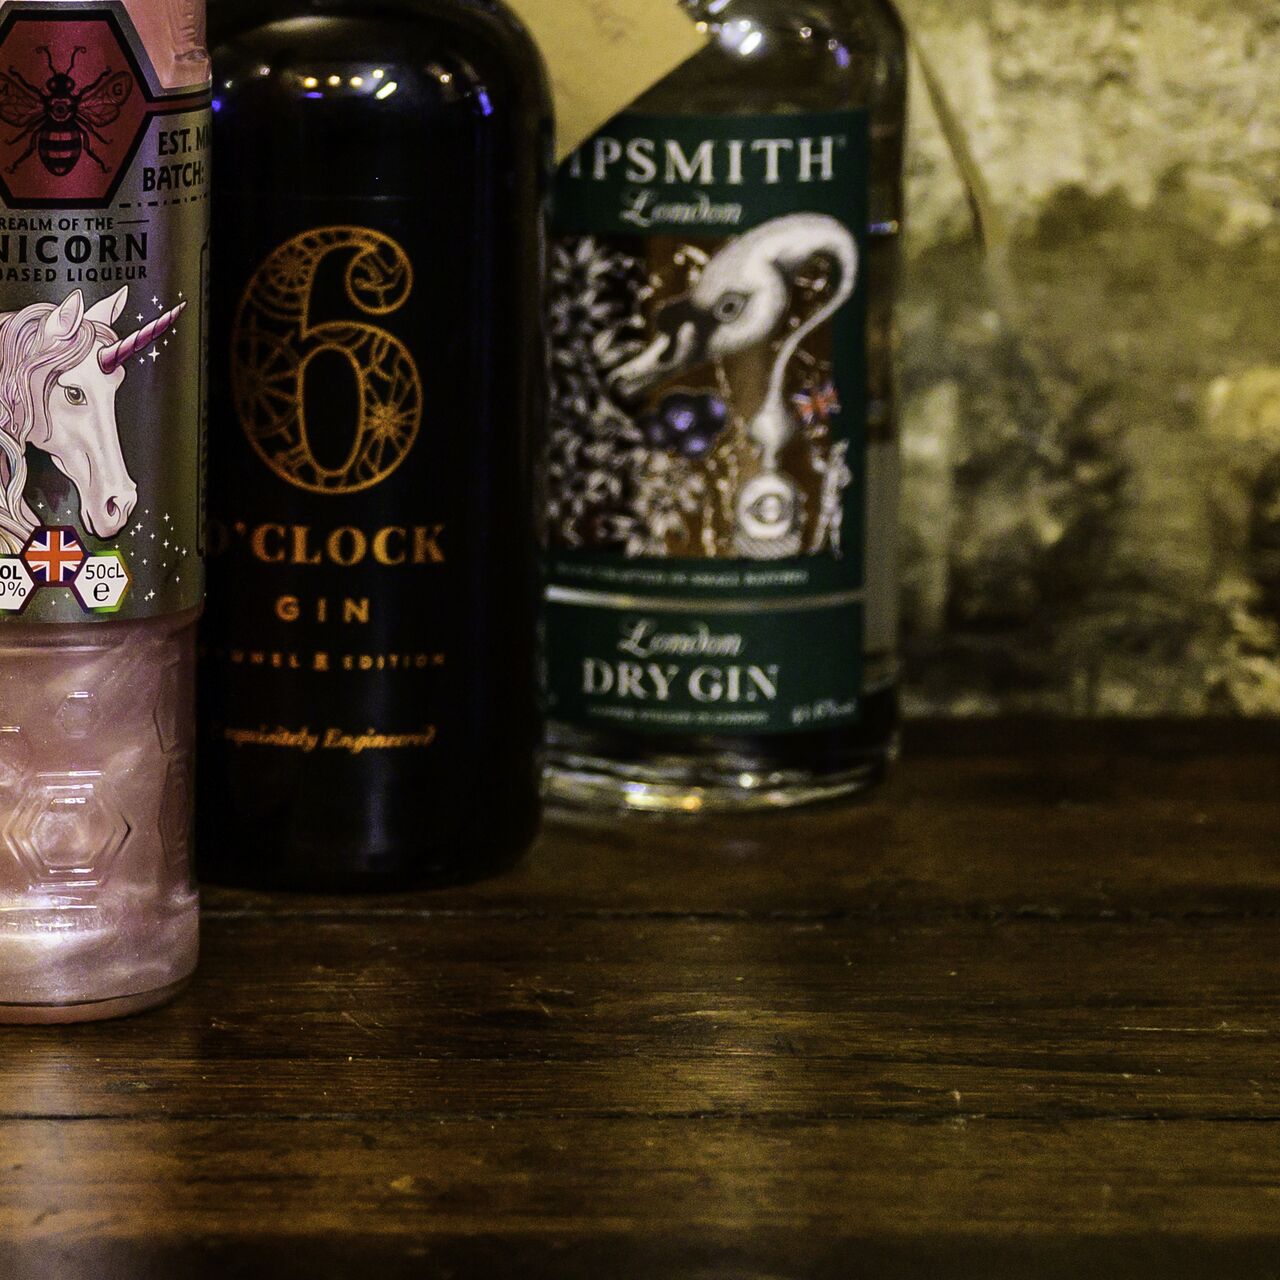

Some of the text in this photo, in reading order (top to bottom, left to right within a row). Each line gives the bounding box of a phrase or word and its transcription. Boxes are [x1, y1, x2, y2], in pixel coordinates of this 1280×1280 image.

[158, 128, 192, 157] EST.
[142, 162, 205, 192] BATCH:
[620, 187, 743, 228] London
[58, 217, 80, 231] OF
[85, 216, 114, 231] THE
[66, 265, 148, 282] LIQUEUR
[230, 225, 423, 495] 6
[276, 595, 370, 623] GIN
[617, 618, 743, 659] London
[583, 657, 780, 703] DRY GIN
